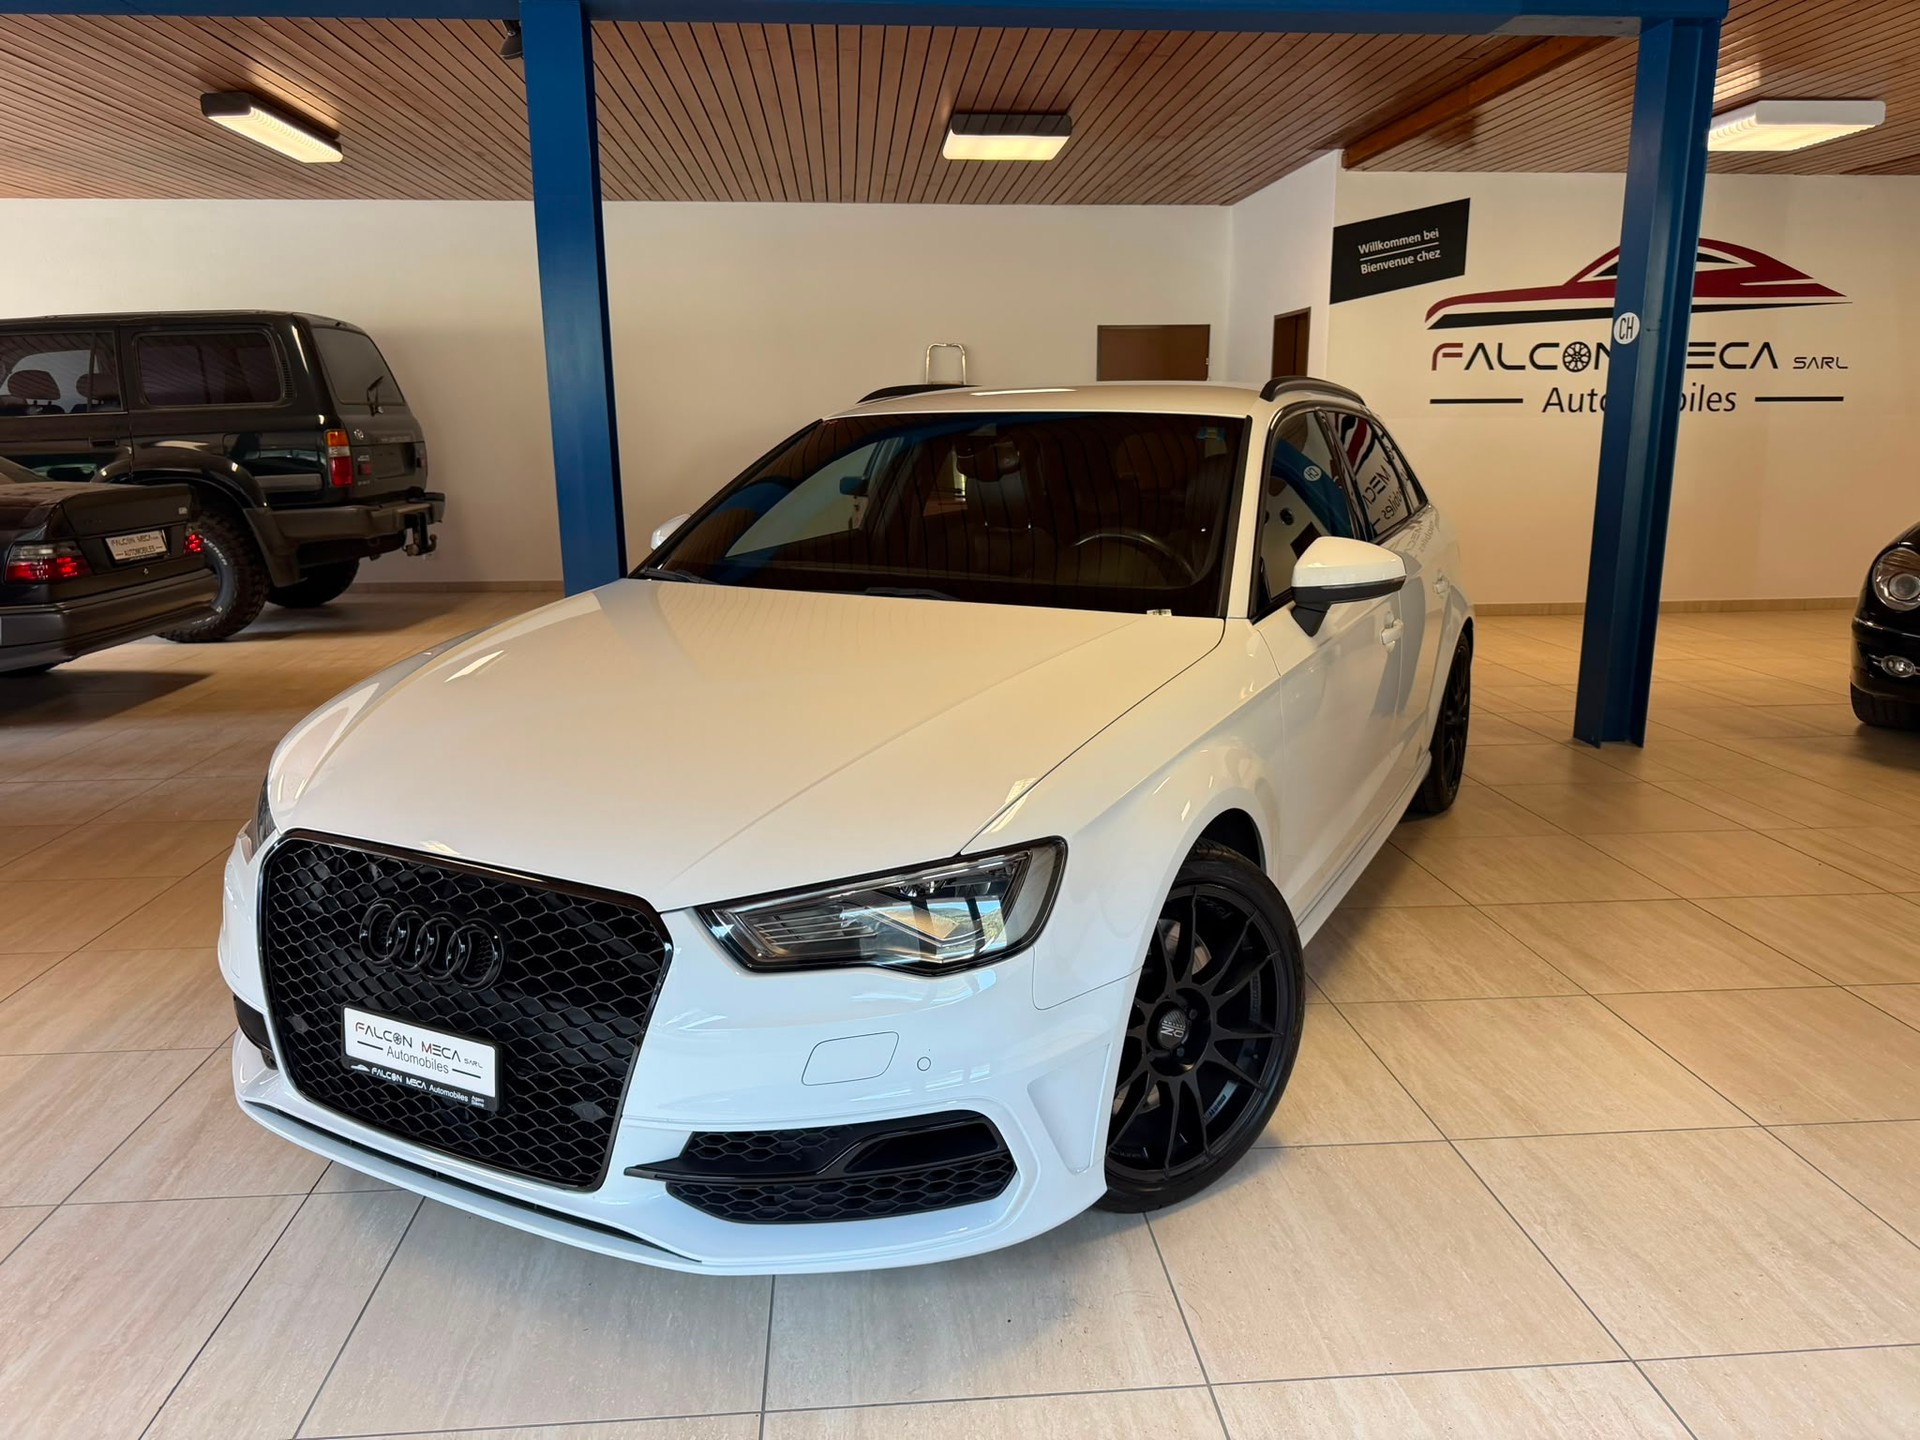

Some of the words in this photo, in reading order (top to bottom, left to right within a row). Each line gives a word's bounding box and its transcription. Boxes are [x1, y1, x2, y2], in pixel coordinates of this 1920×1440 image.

[1358, 234, 1421, 254] Willkommen
[1423, 228, 1439, 240] bei
[1360, 255, 1415, 274] Bienvenue
[1417, 250, 1441, 262] chez
[1619, 316, 1634, 340] CH
[1686, 341, 1779, 370] ECA
[1792, 356, 1849, 370] SARL
[1541, 382, 1737, 413] Autiles
[355, 1021, 413, 1048] FALCON
[421, 1041, 461, 1062] MECA
[463, 1058, 483, 1069] SARL
[387, 1045, 449, 1074] Automobiles
[371, 1067, 403, 1083] FALCON
[405, 1077, 427, 1090] MECA
[429, 1084, 468, 1102] Automobiles
